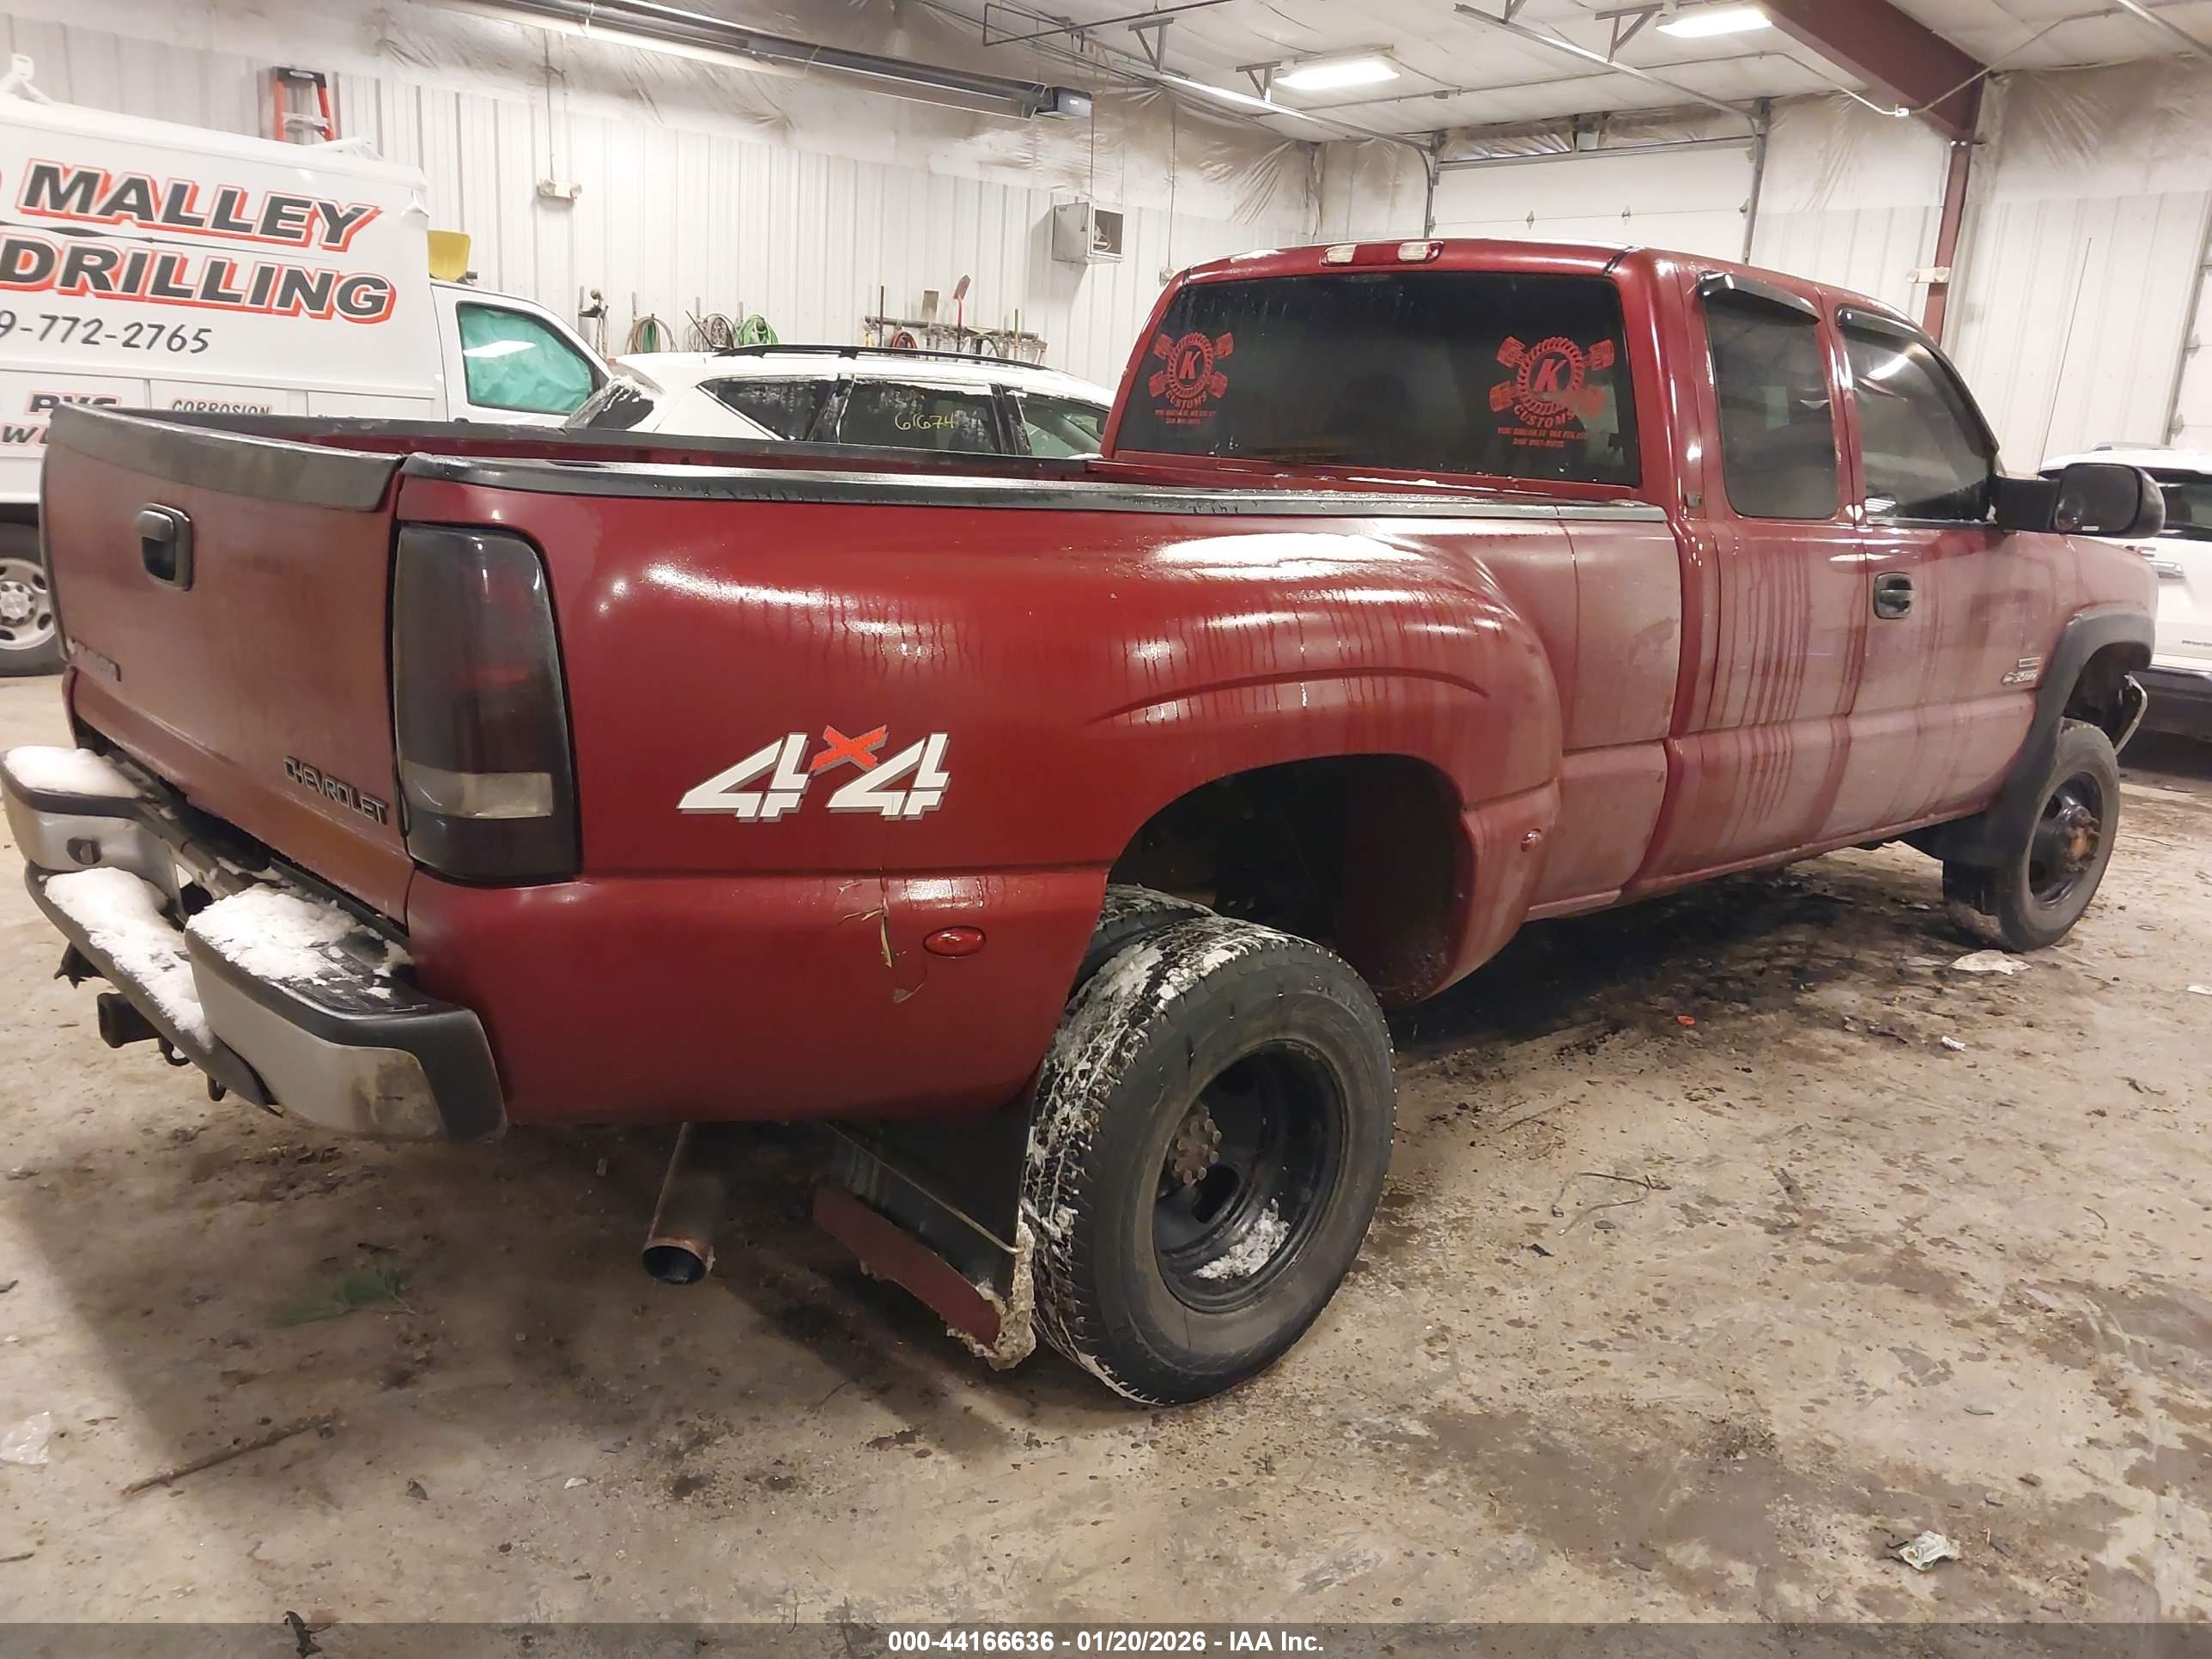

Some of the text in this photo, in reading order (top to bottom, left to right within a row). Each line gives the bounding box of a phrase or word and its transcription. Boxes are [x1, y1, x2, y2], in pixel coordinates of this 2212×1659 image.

[15, 159, 382, 252] MALLEY
[0, 233, 397, 324] DRILLING
[0, 310, 213, 354] 9-772-2765
[1179, 350, 1201, 380] K
[1533, 358, 1567, 393] K
[1165, 390, 1207, 409] CUSTOMS
[1514, 404, 1575, 428] CUSTOMS
[283, 755, 386, 826] CHEVROLET
